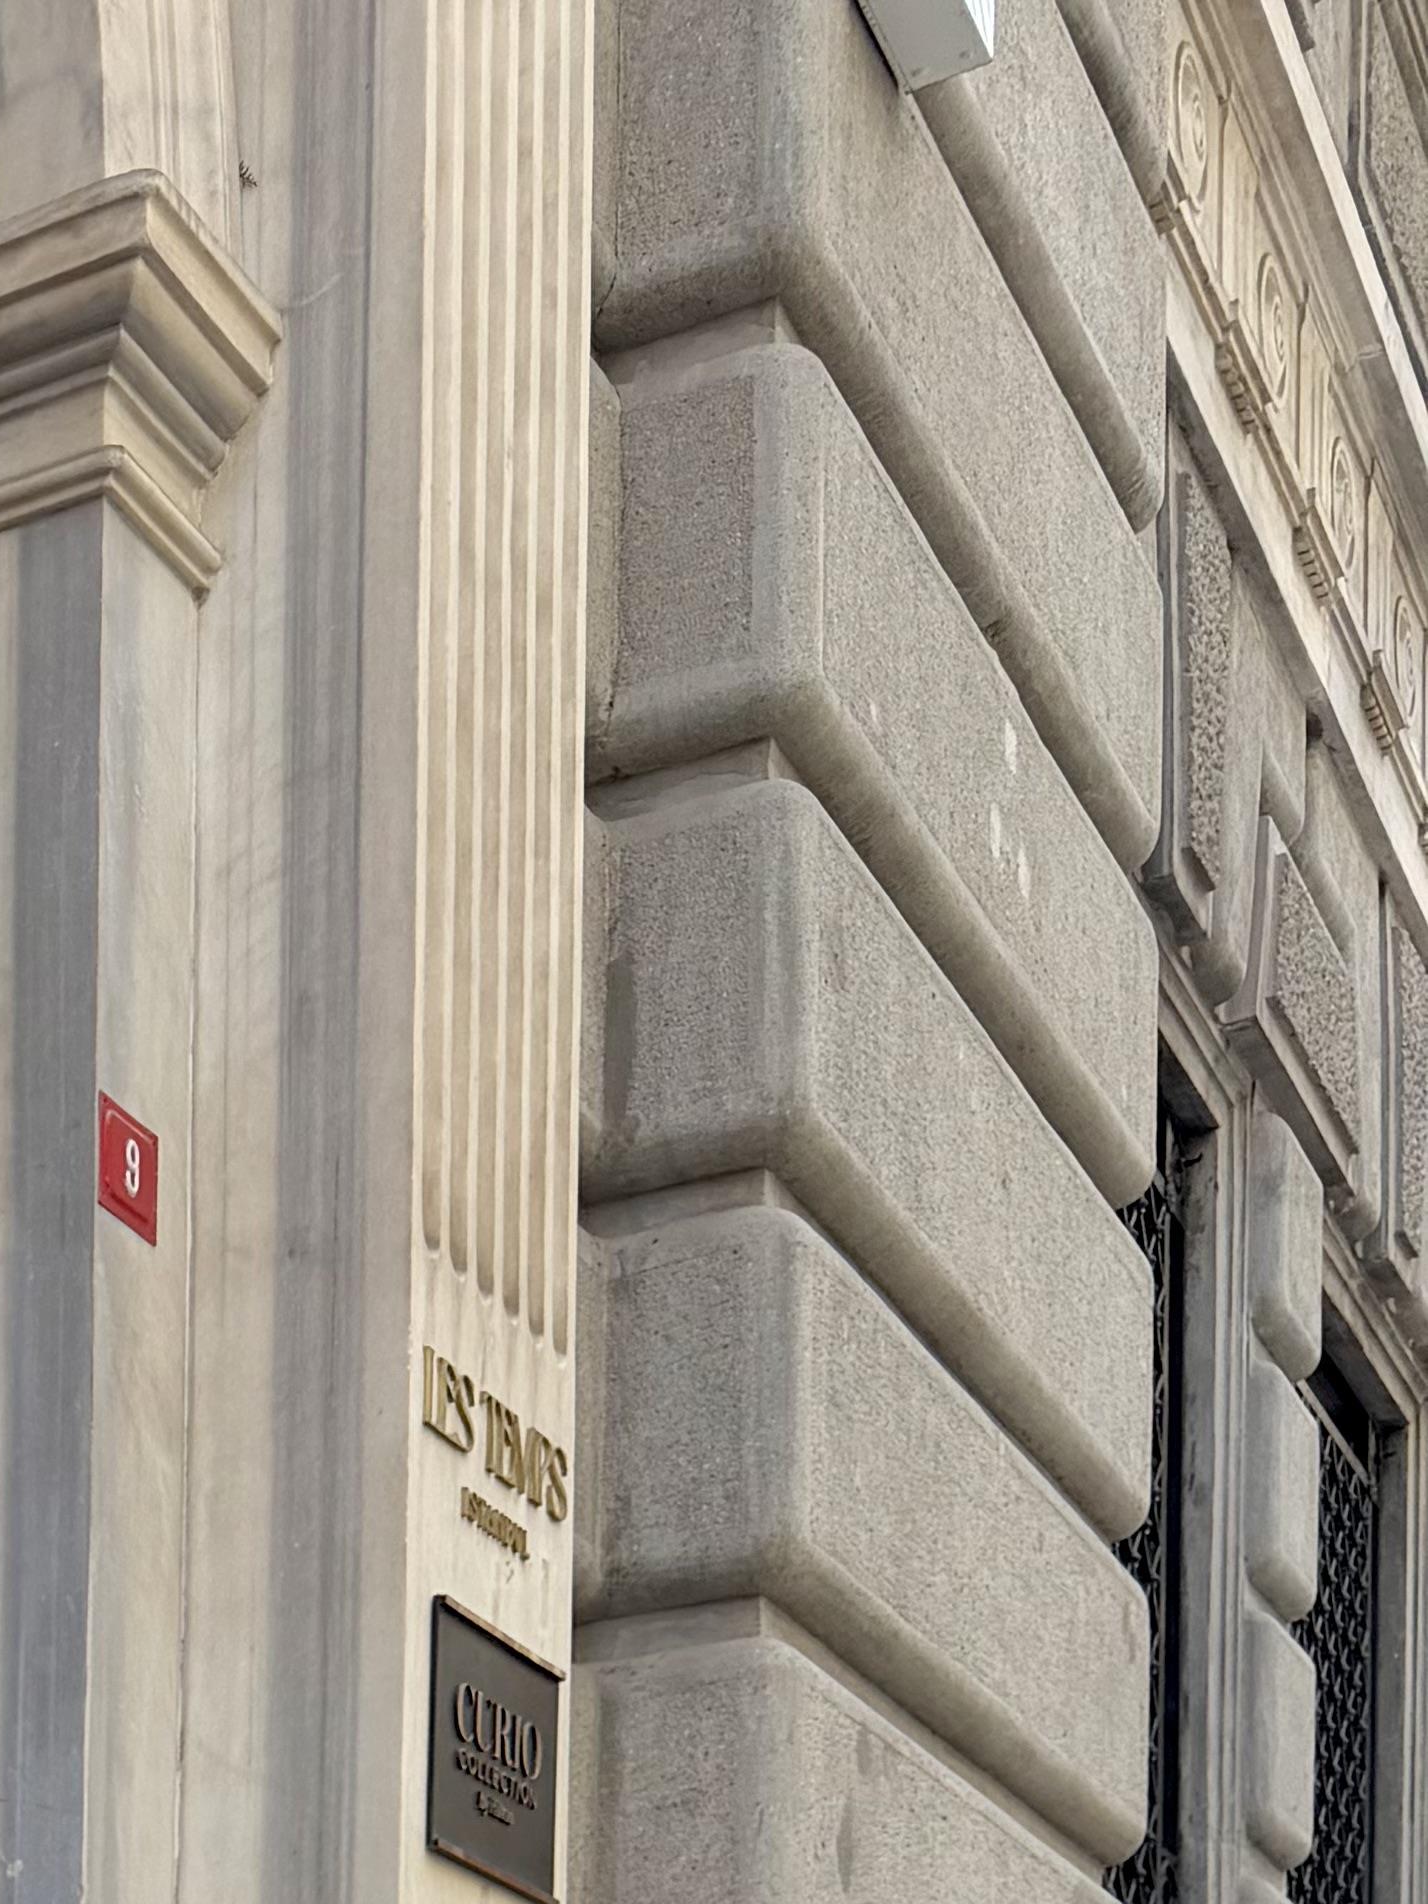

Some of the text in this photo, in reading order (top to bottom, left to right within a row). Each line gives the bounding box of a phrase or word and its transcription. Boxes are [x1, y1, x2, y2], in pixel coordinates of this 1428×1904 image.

[125, 1138, 140, 1198] 9
[422, 1345, 568, 1521] LES TEMPS
[454, 1682, 542, 1781] CURIO
[455, 1747, 537, 1811] COLLECTION
